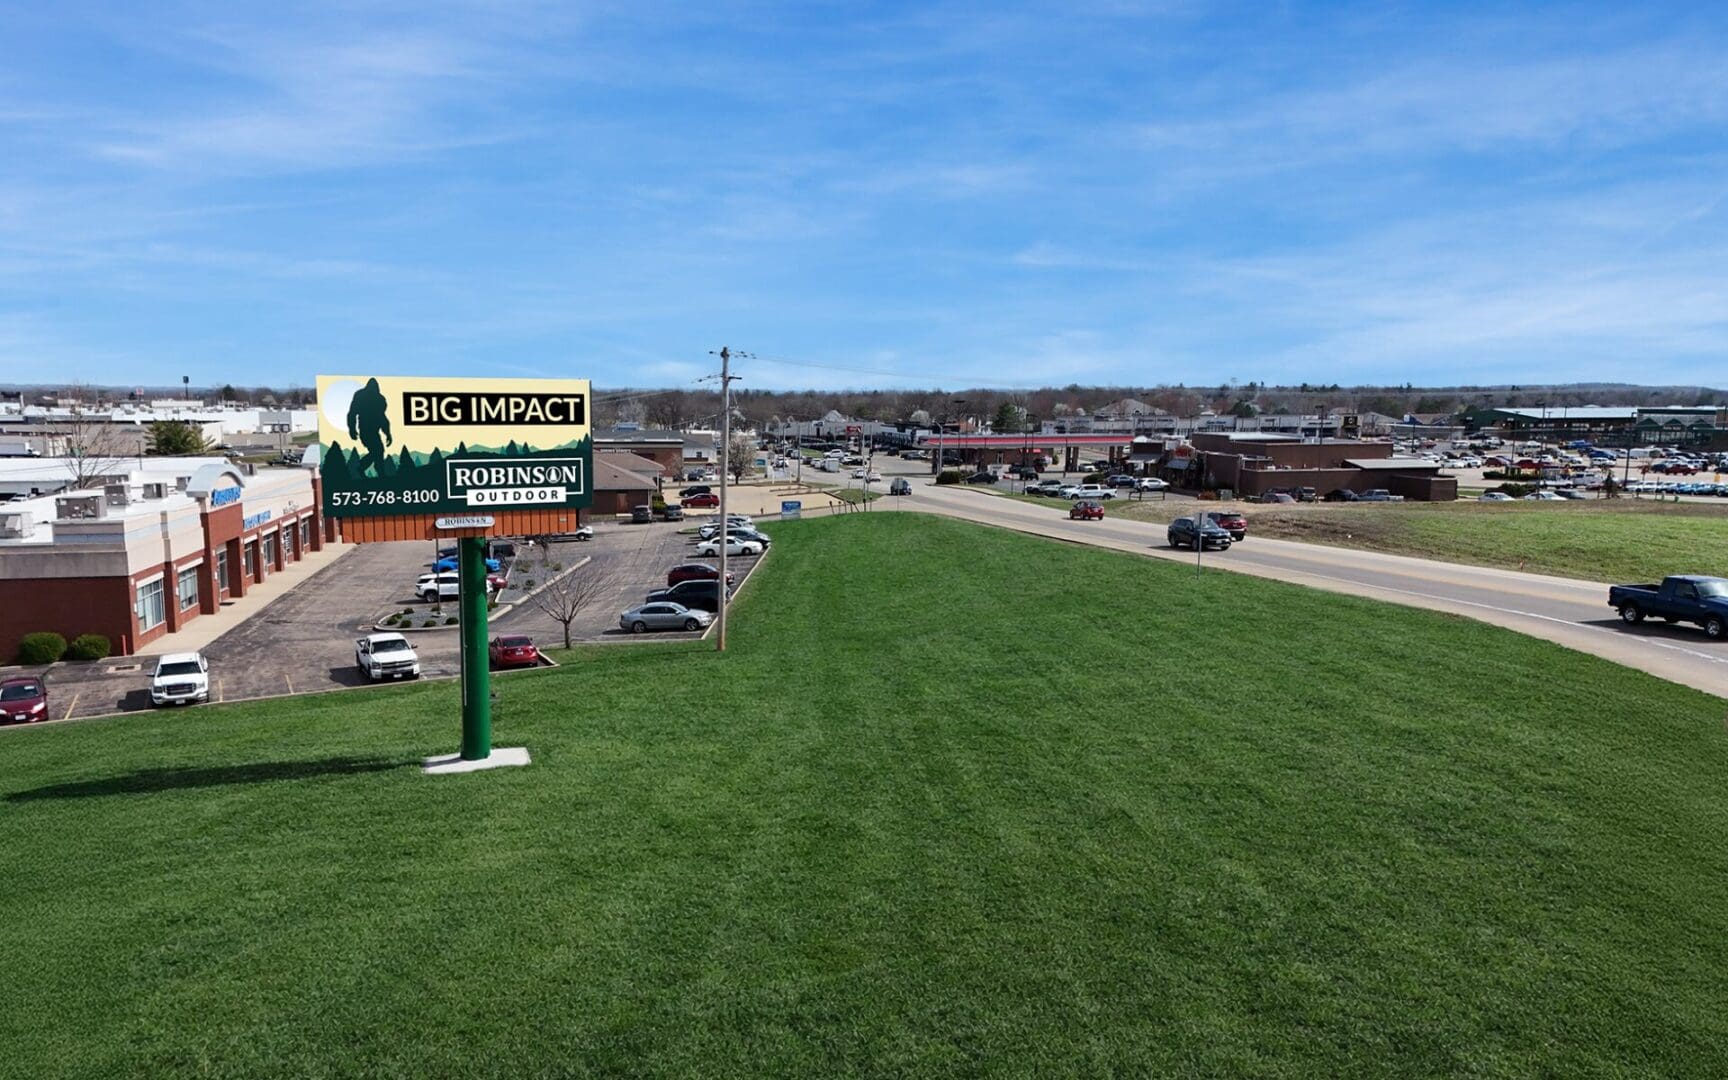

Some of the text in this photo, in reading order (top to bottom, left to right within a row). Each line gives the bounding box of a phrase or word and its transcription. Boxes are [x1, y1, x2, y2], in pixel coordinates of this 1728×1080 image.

[410, 396, 580, 422] BIG IMPACT
[454, 465, 576, 486] ROBINSON
[332, 489, 439, 506] 573-768-8100
[476, 489, 559, 502] OUTDOOR
